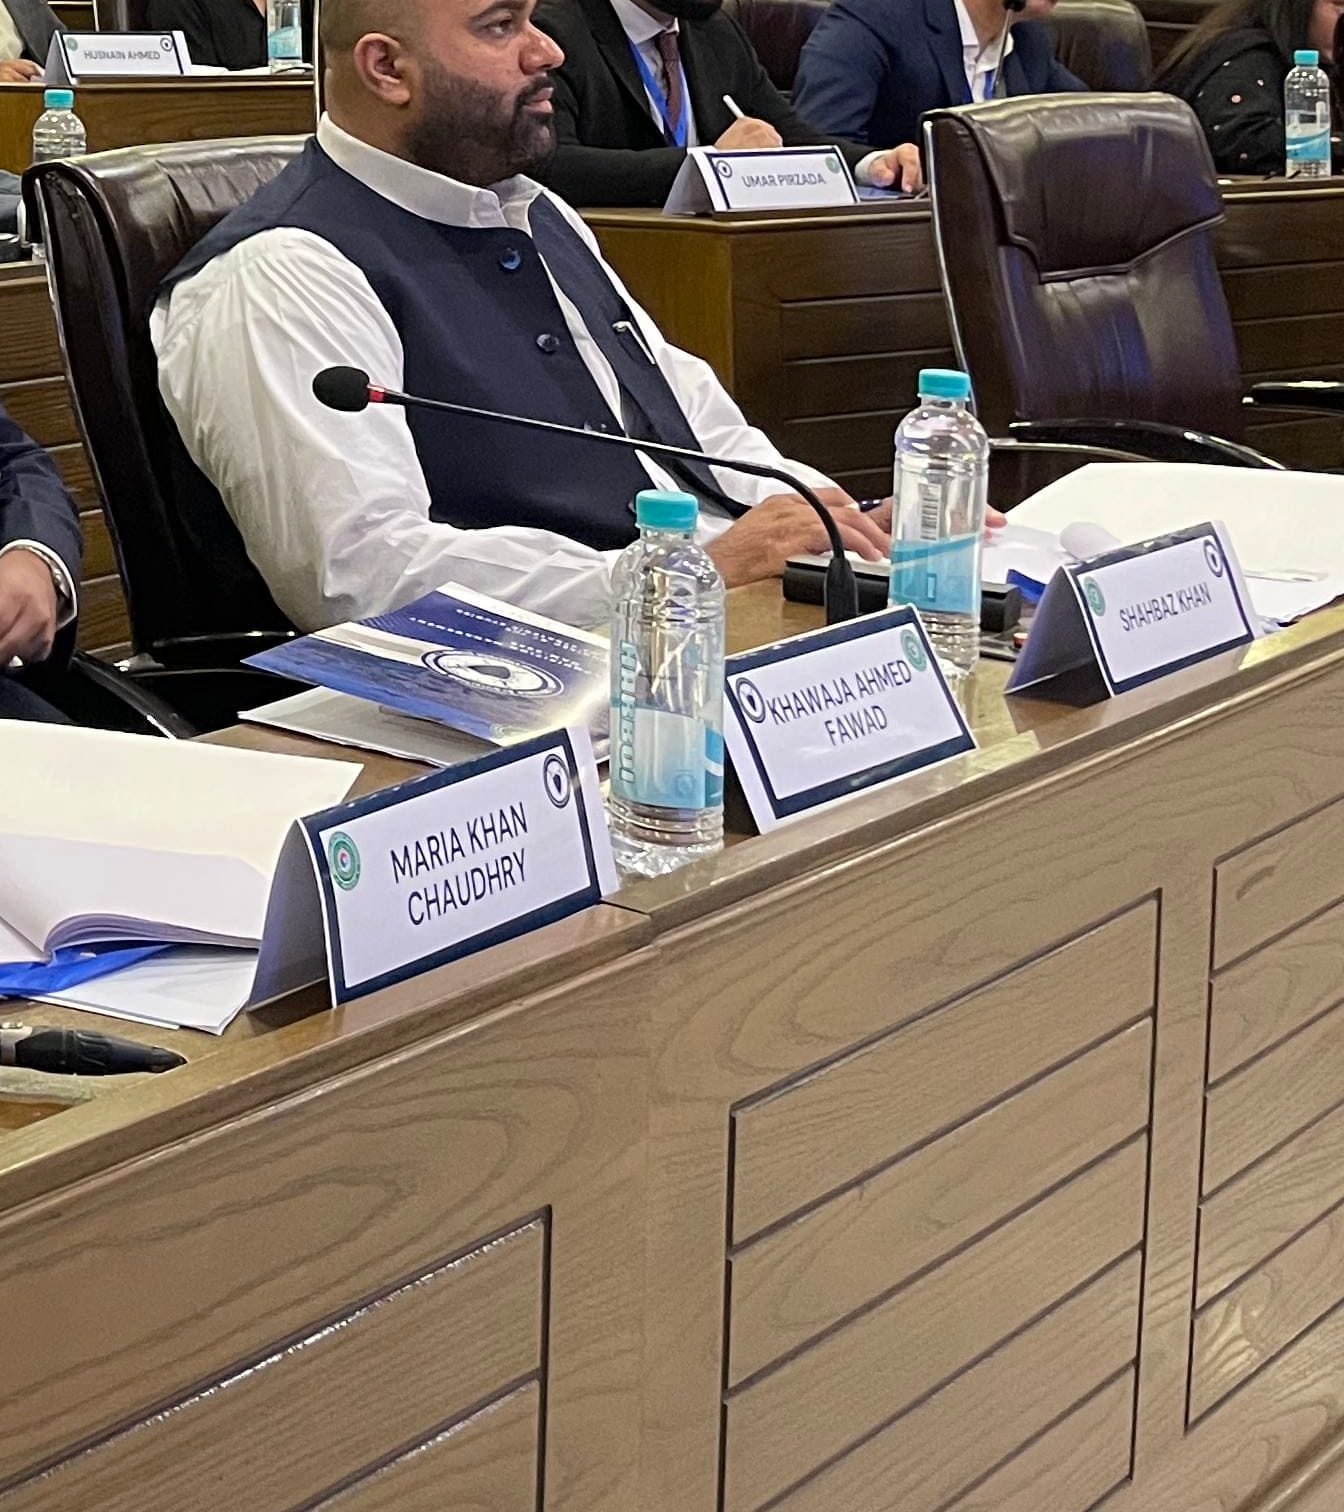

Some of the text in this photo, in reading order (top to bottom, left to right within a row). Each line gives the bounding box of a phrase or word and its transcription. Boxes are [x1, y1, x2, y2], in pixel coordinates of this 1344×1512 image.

[127, 50, 161, 60] AHMED
[741, 173, 828, 188] UMAR PIRZADA
[1119, 582, 1212, 632] SHAHBAZ KHAN
[766, 659, 913, 726] KHAWAJA AHMED
[824, 704, 888, 746] FAWAD
[390, 826, 466, 884] MARIA
[466, 801, 528, 854] KHAN
[408, 847, 525, 926] CHAUDHRY
